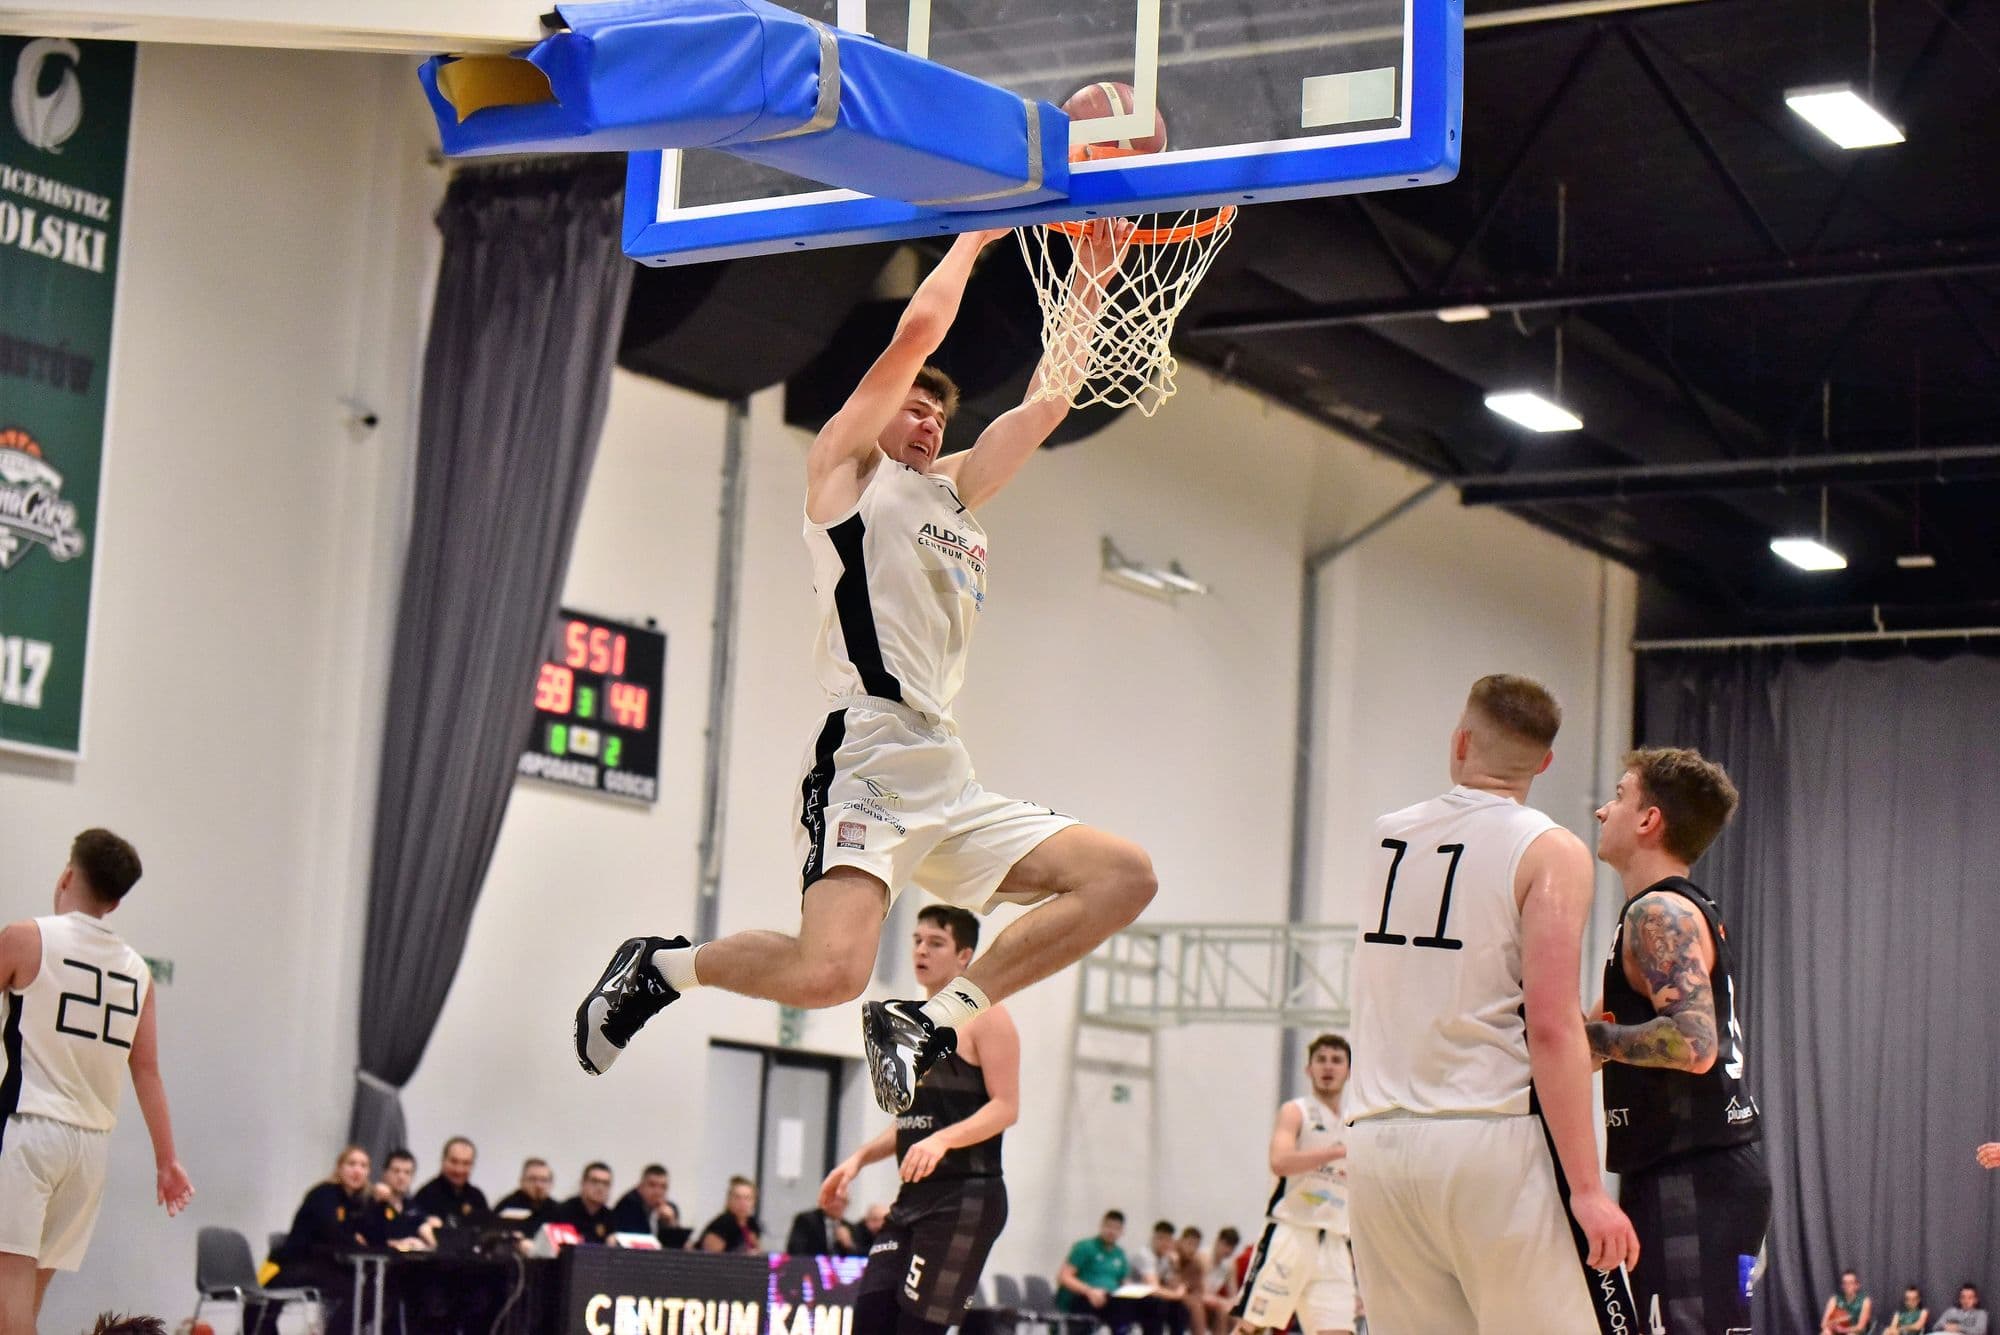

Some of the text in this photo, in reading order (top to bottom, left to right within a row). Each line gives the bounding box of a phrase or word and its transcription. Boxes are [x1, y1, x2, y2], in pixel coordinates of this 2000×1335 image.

[917, 537, 962, 560] CENTRUM
[609, 682, 649, 730] 44
[604, 736, 622, 768] 2
[843, 802, 882, 822] Zielona
[1364, 838, 1464, 950] 11
[56, 958, 138, 1049] 22
[906, 1254, 926, 1289] 5
[585, 1293, 760, 1335] CENTRUM
